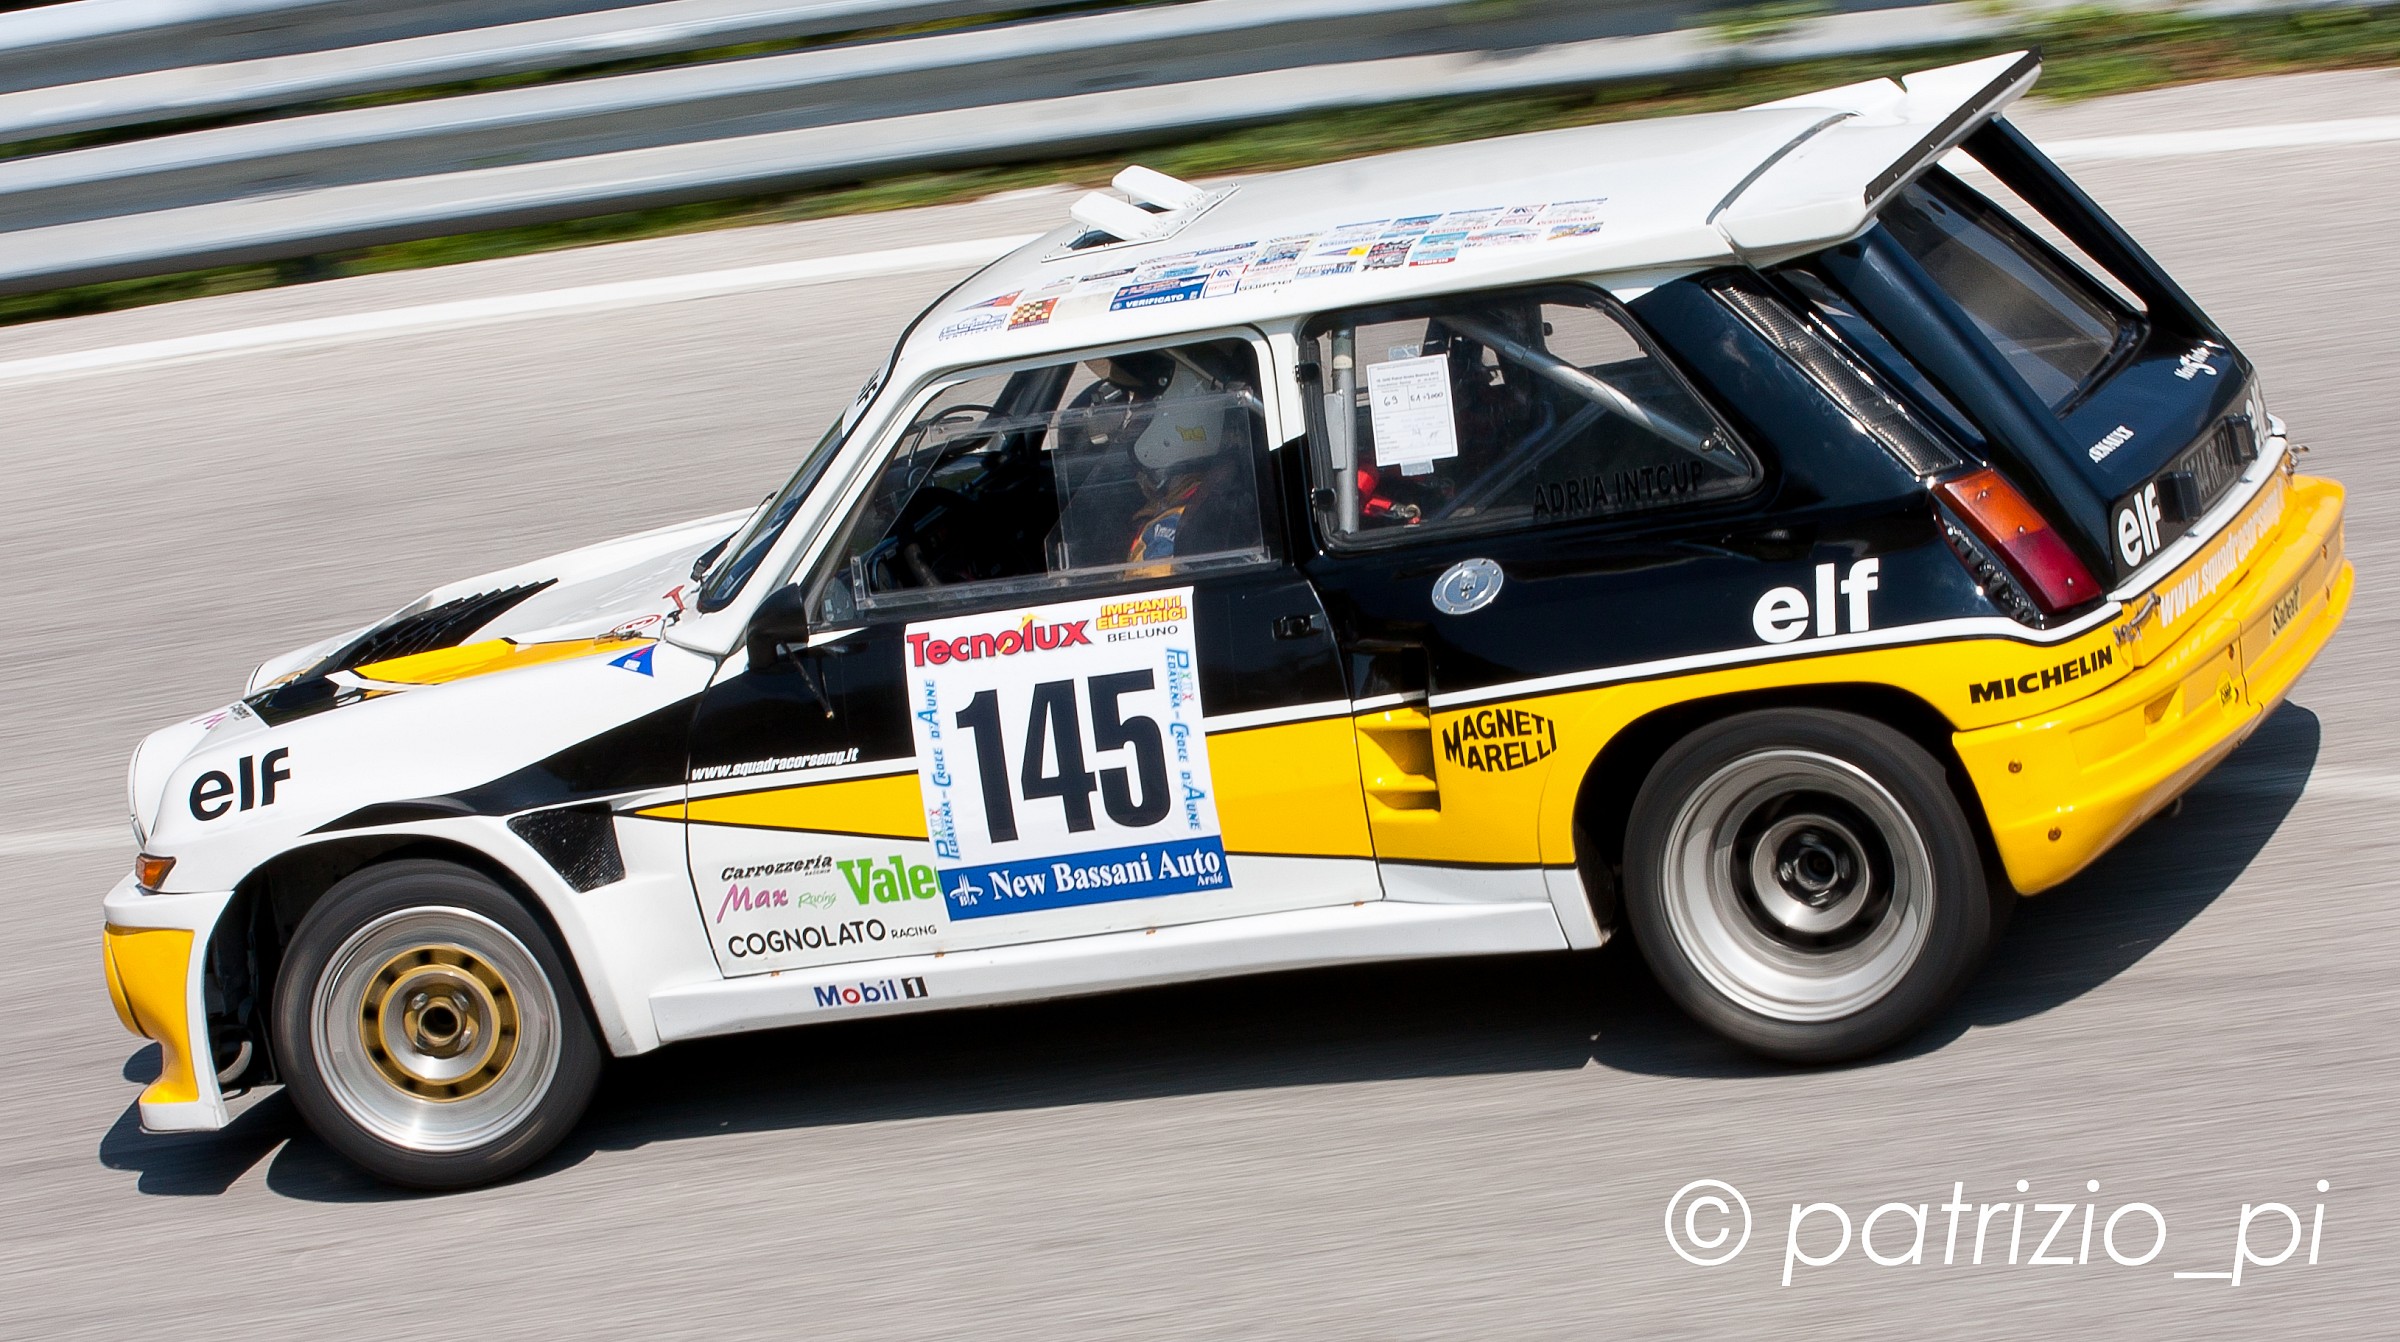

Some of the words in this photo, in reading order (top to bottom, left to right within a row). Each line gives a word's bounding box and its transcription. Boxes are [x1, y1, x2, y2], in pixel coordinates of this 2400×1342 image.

[1125, 294, 1184, 309] VERIFICATO
[1534, 475, 1609, 515] ADRIA
[1614, 460, 1705, 504] INTCUP
[2117, 482, 2162, 567] elf
[1096, 606, 1188, 631] ELETTRICI
[1101, 595, 1183, 618] IMPIANTI
[1753, 558, 1879, 644] elf
[907, 619, 1094, 667] Tecnolux
[1107, 625, 1178, 643] BELLUNO
[1968, 645, 2113, 704] MICHELIN
[1442, 709, 1557, 750] MAGNETI
[691, 747, 859, 781] www.squadracorsemg.it
[955, 668, 1171, 844] 145
[189, 746, 292, 822] elf
[721, 854, 833, 882] Carrozzeria
[836, 854, 944, 906] Vale
[988, 867, 1047, 901] New
[1051, 851, 1153, 893] Bassani
[1157, 847, 1222, 881] Auto
[717, 883, 789, 924] Max
[798, 891, 837, 911] Racing
[728, 918, 887, 958] COGNOLATO
[891, 924, 938, 940] RACING
[813, 978, 899, 1008] Mobil
